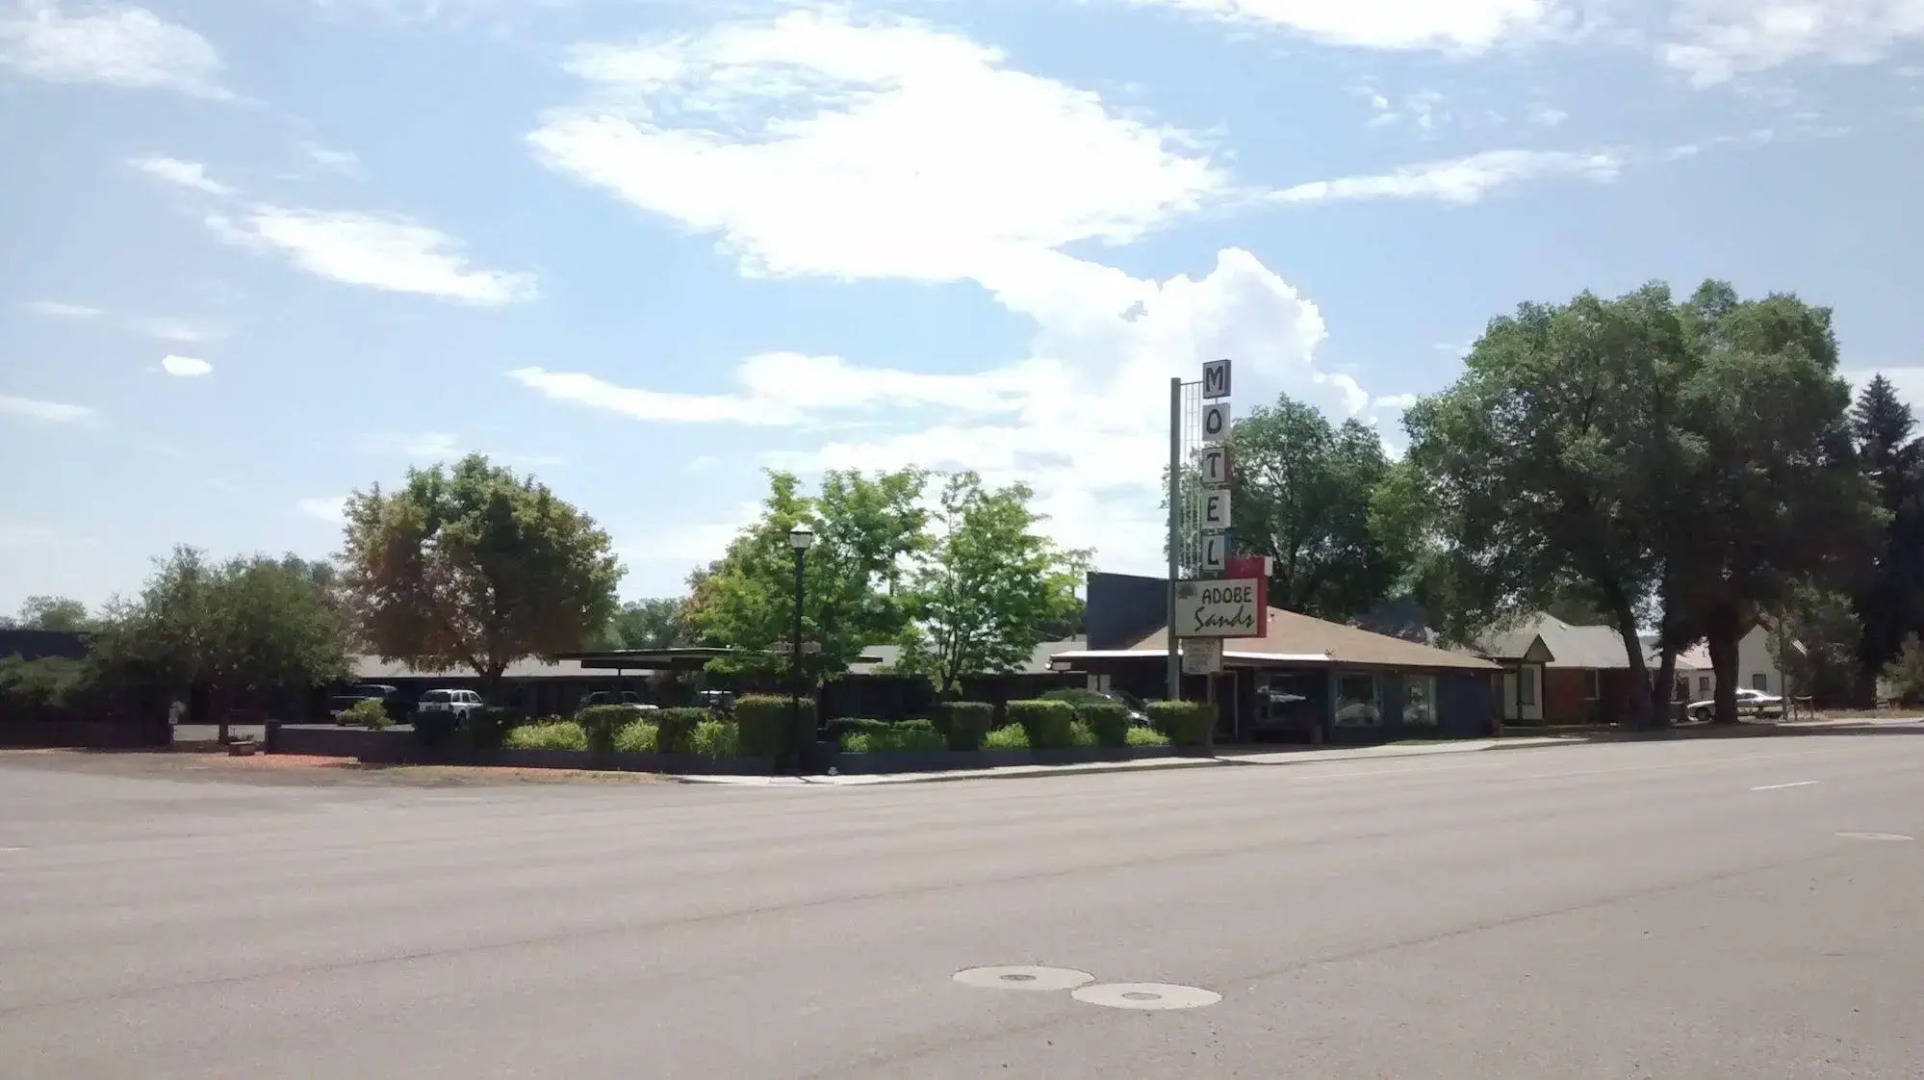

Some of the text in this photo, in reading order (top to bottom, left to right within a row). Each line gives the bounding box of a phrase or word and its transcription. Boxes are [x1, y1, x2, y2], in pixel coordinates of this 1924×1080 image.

[1205, 366, 1223, 565] MOTEL
[1201, 586, 1252, 604] ADOBE
[1194, 604, 1255, 632] Sands
